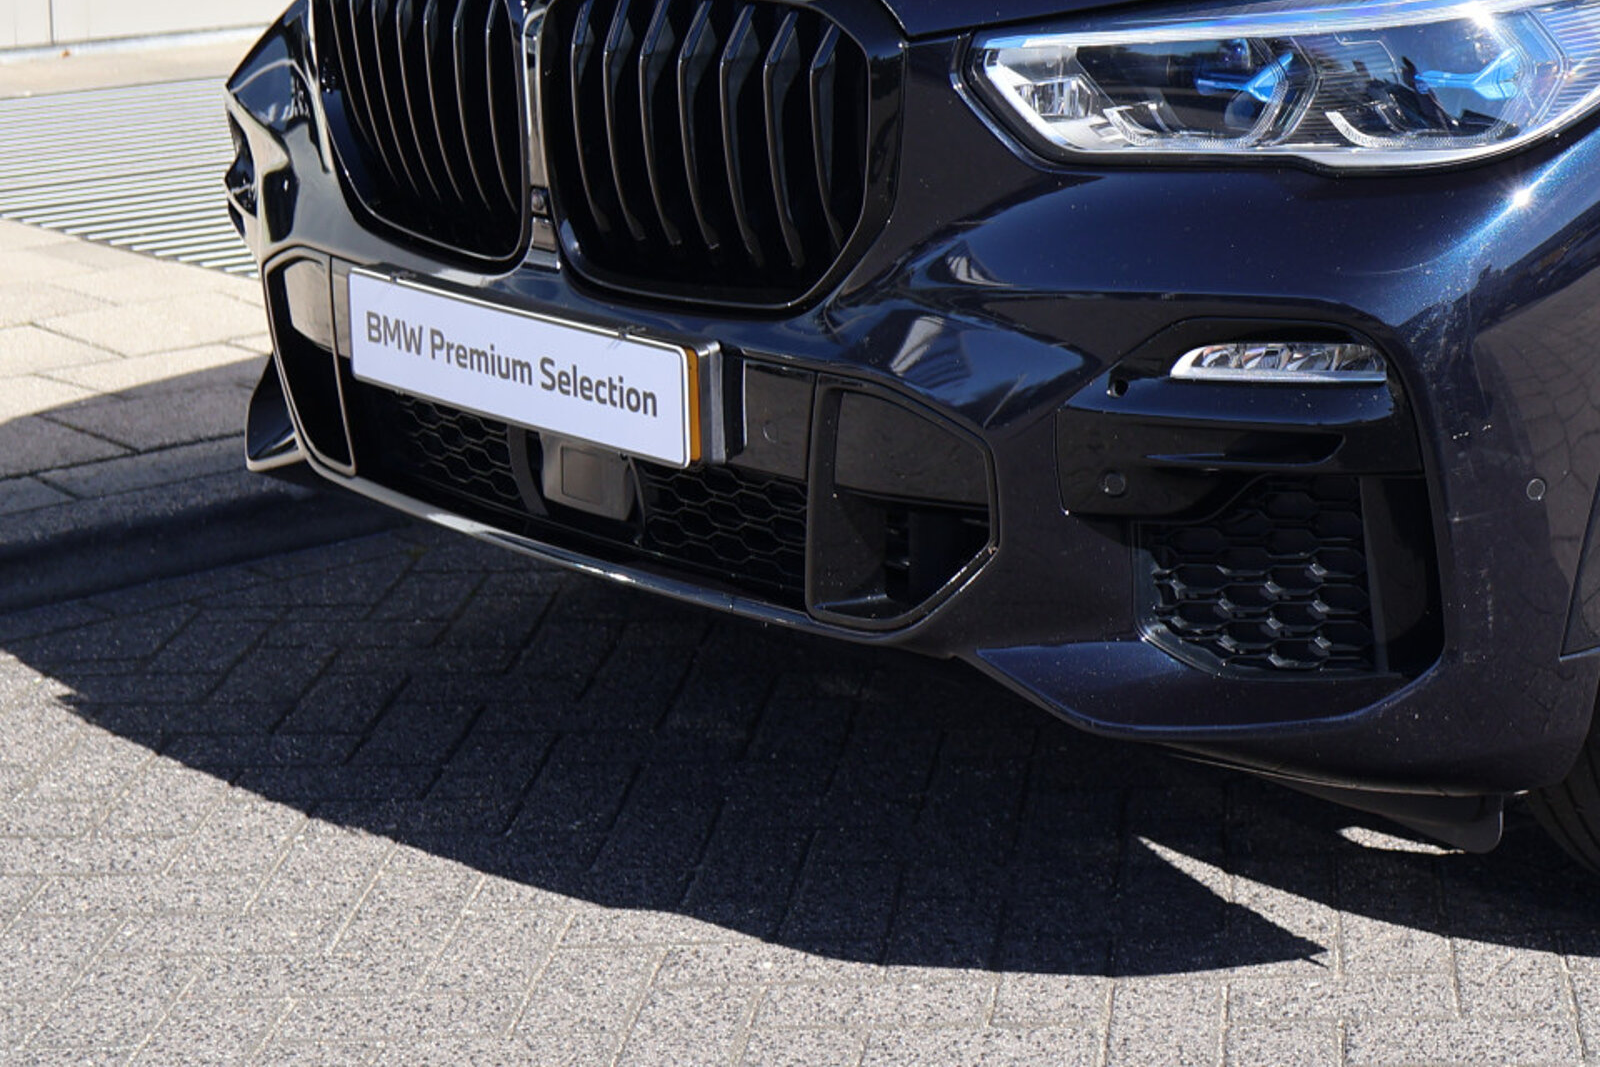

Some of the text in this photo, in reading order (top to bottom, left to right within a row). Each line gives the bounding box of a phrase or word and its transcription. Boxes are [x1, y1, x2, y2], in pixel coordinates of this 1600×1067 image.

[366, 310, 657, 417] BMW Premium Selection
